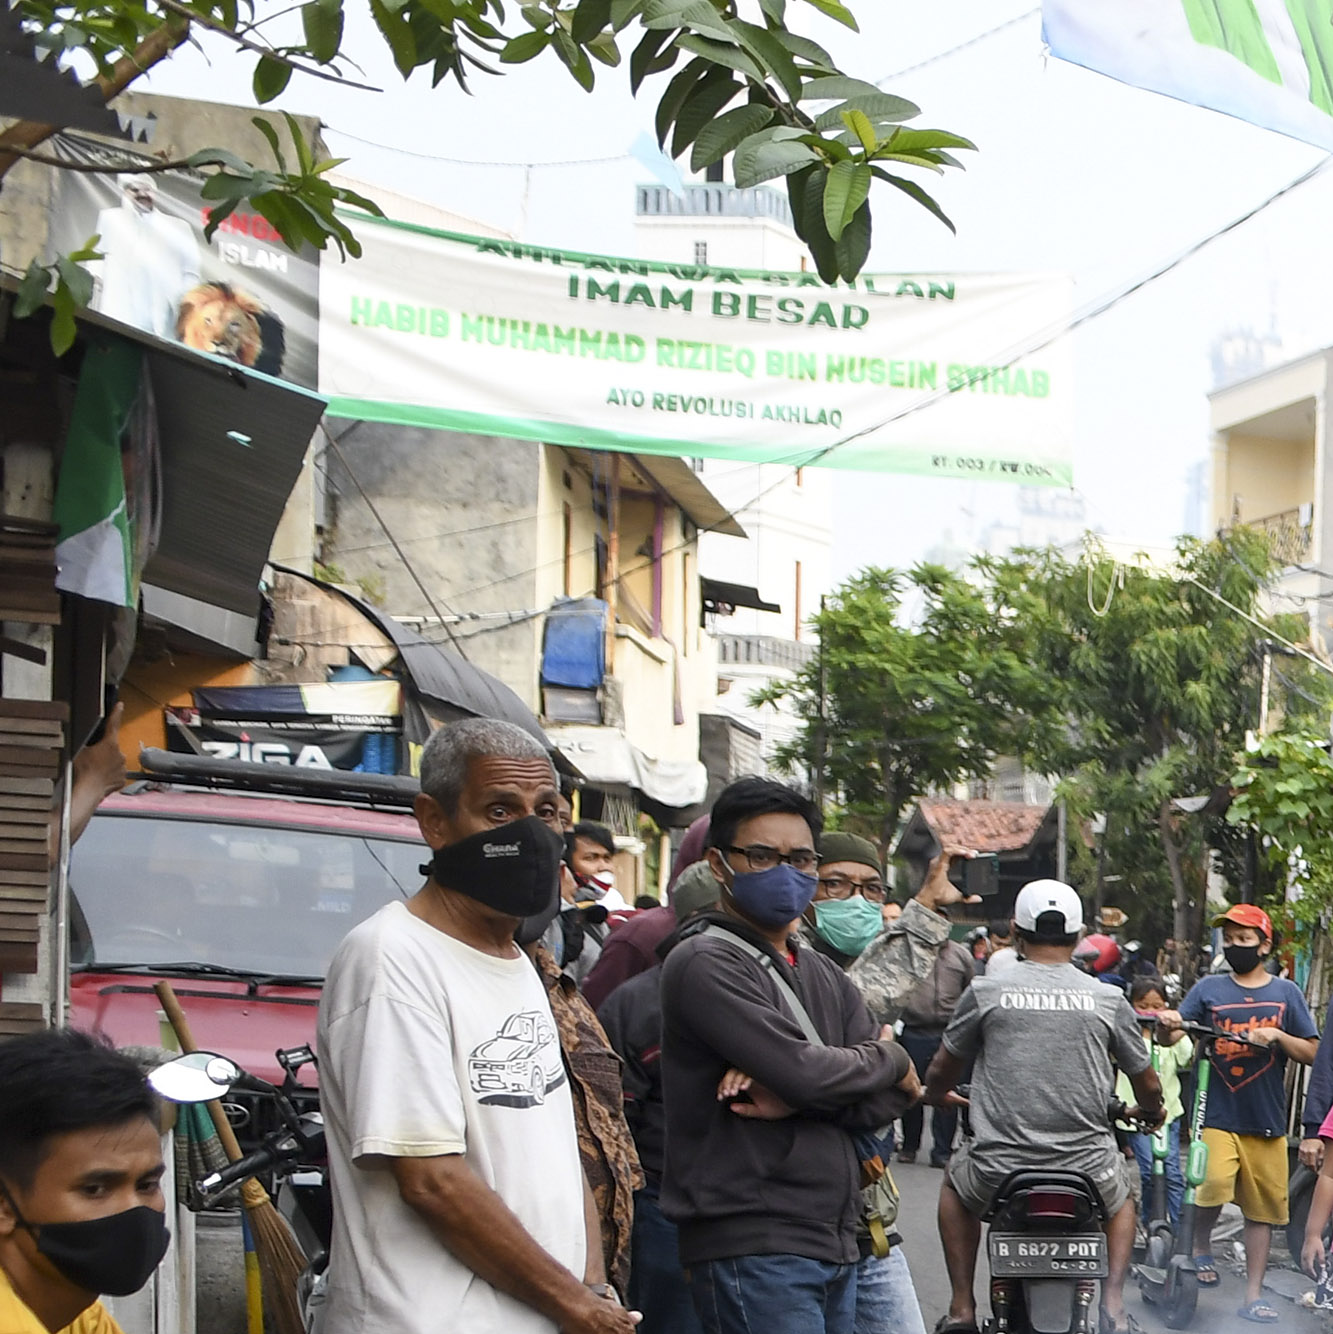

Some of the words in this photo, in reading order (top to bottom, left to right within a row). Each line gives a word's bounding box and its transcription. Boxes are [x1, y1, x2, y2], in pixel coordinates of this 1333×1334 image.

[218, 241, 288, 273] ISLAM
[569, 273, 694, 312] IMAM
[712, 290, 870, 331] BESAR
[350, 295, 449, 338] HABIB
[460, 312, 646, 363] MUHAMMAD
[657, 337, 756, 378] RIZIEQ
[766, 350, 817, 381] BIN
[826, 353, 937, 390] HUSEIN
[946, 363, 1050, 399] SYIHAB
[606, 388, 645, 408] AYO
[652, 391, 754, 419] REVOLUSI
[761, 402, 843, 429] AKHLAQ
[1000, 992, 1096, 1012] COMMAND
